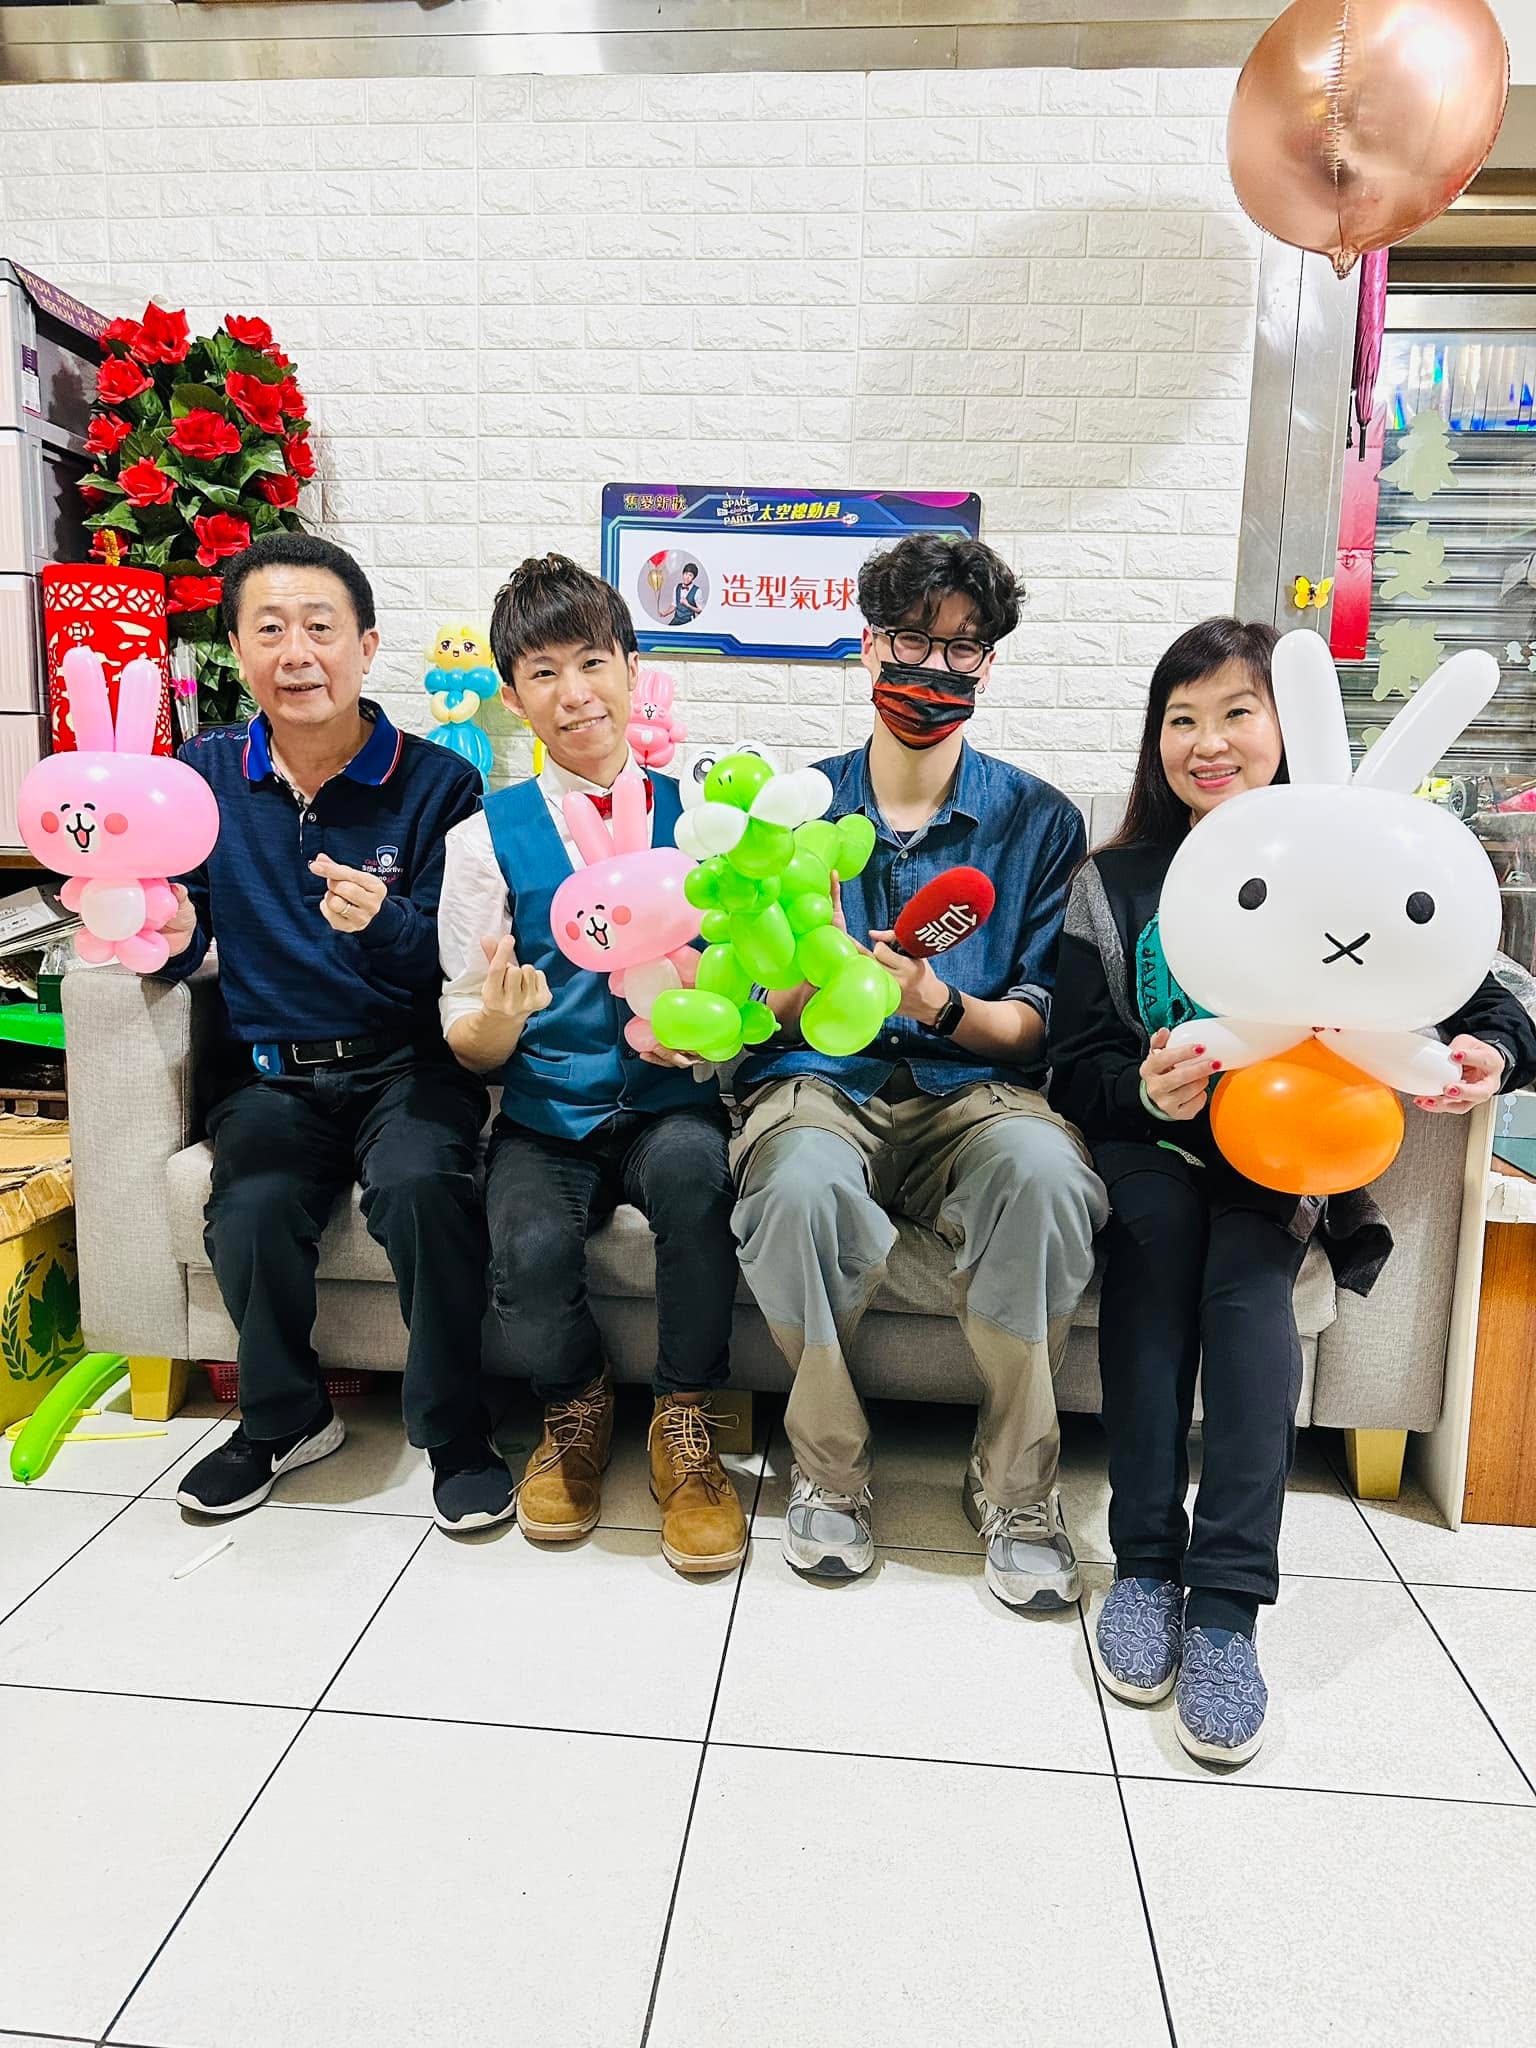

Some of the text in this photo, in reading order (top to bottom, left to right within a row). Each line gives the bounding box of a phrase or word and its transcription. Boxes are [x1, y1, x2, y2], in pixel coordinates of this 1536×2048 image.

[78, 318, 104, 337] OUSE
[722, 498, 752, 509] SPACE
[757, 501, 841, 521] 太空總動員
[723, 514, 755, 526] PARTY
[720, 574, 857, 611] 造型氣球
[914, 903, 977, 952] 台視
[1142, 947, 1158, 1009] JAVA
